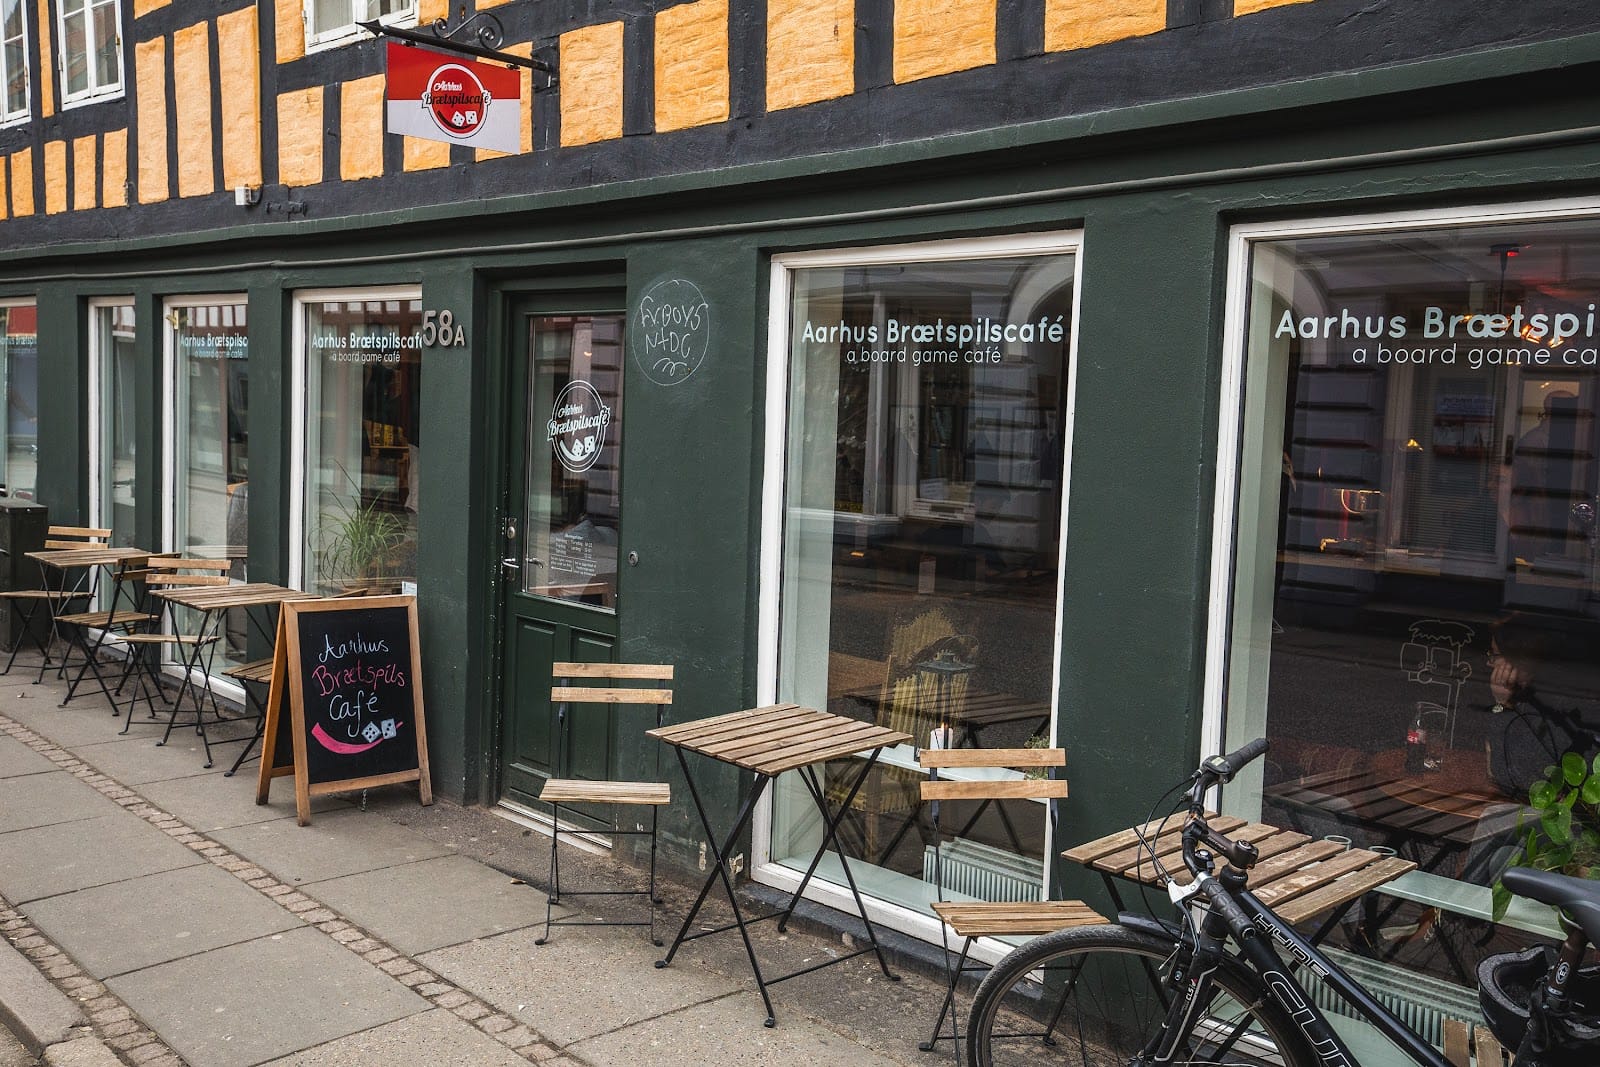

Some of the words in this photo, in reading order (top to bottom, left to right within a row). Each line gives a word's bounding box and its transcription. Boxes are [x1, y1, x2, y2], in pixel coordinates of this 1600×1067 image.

[180, 332, 205, 347] Aarhus
[312, 332, 347, 348] Aarhus
[801, 319, 878, 343] Aarhus
[887, 315, 1064, 349] Brætspilscafé
[1275, 308, 1407, 339] Aarhus
[1423, 303, 1596, 346] Brætspi
[332, 353, 337, 362] a
[338, 351, 360, 362] board
[362, 353, 382, 364] game
[384, 350, 401, 362] café
[847, 350, 856, 363] a
[861, 346, 906, 363] board
[912, 350, 958, 367] game
[964, 346, 1001, 363] café
[1352, 348, 1367, 364] a
[1377, 343, 1457, 364] board
[1468, 349, 1551, 369] game
[1563, 348, 1597, 365] ca
[319, 632, 389, 663] Aarhus
[311, 659, 405, 696] Brætspils
[329, 690, 380, 738] Café
[1263, 971, 1353, 1067] CU
